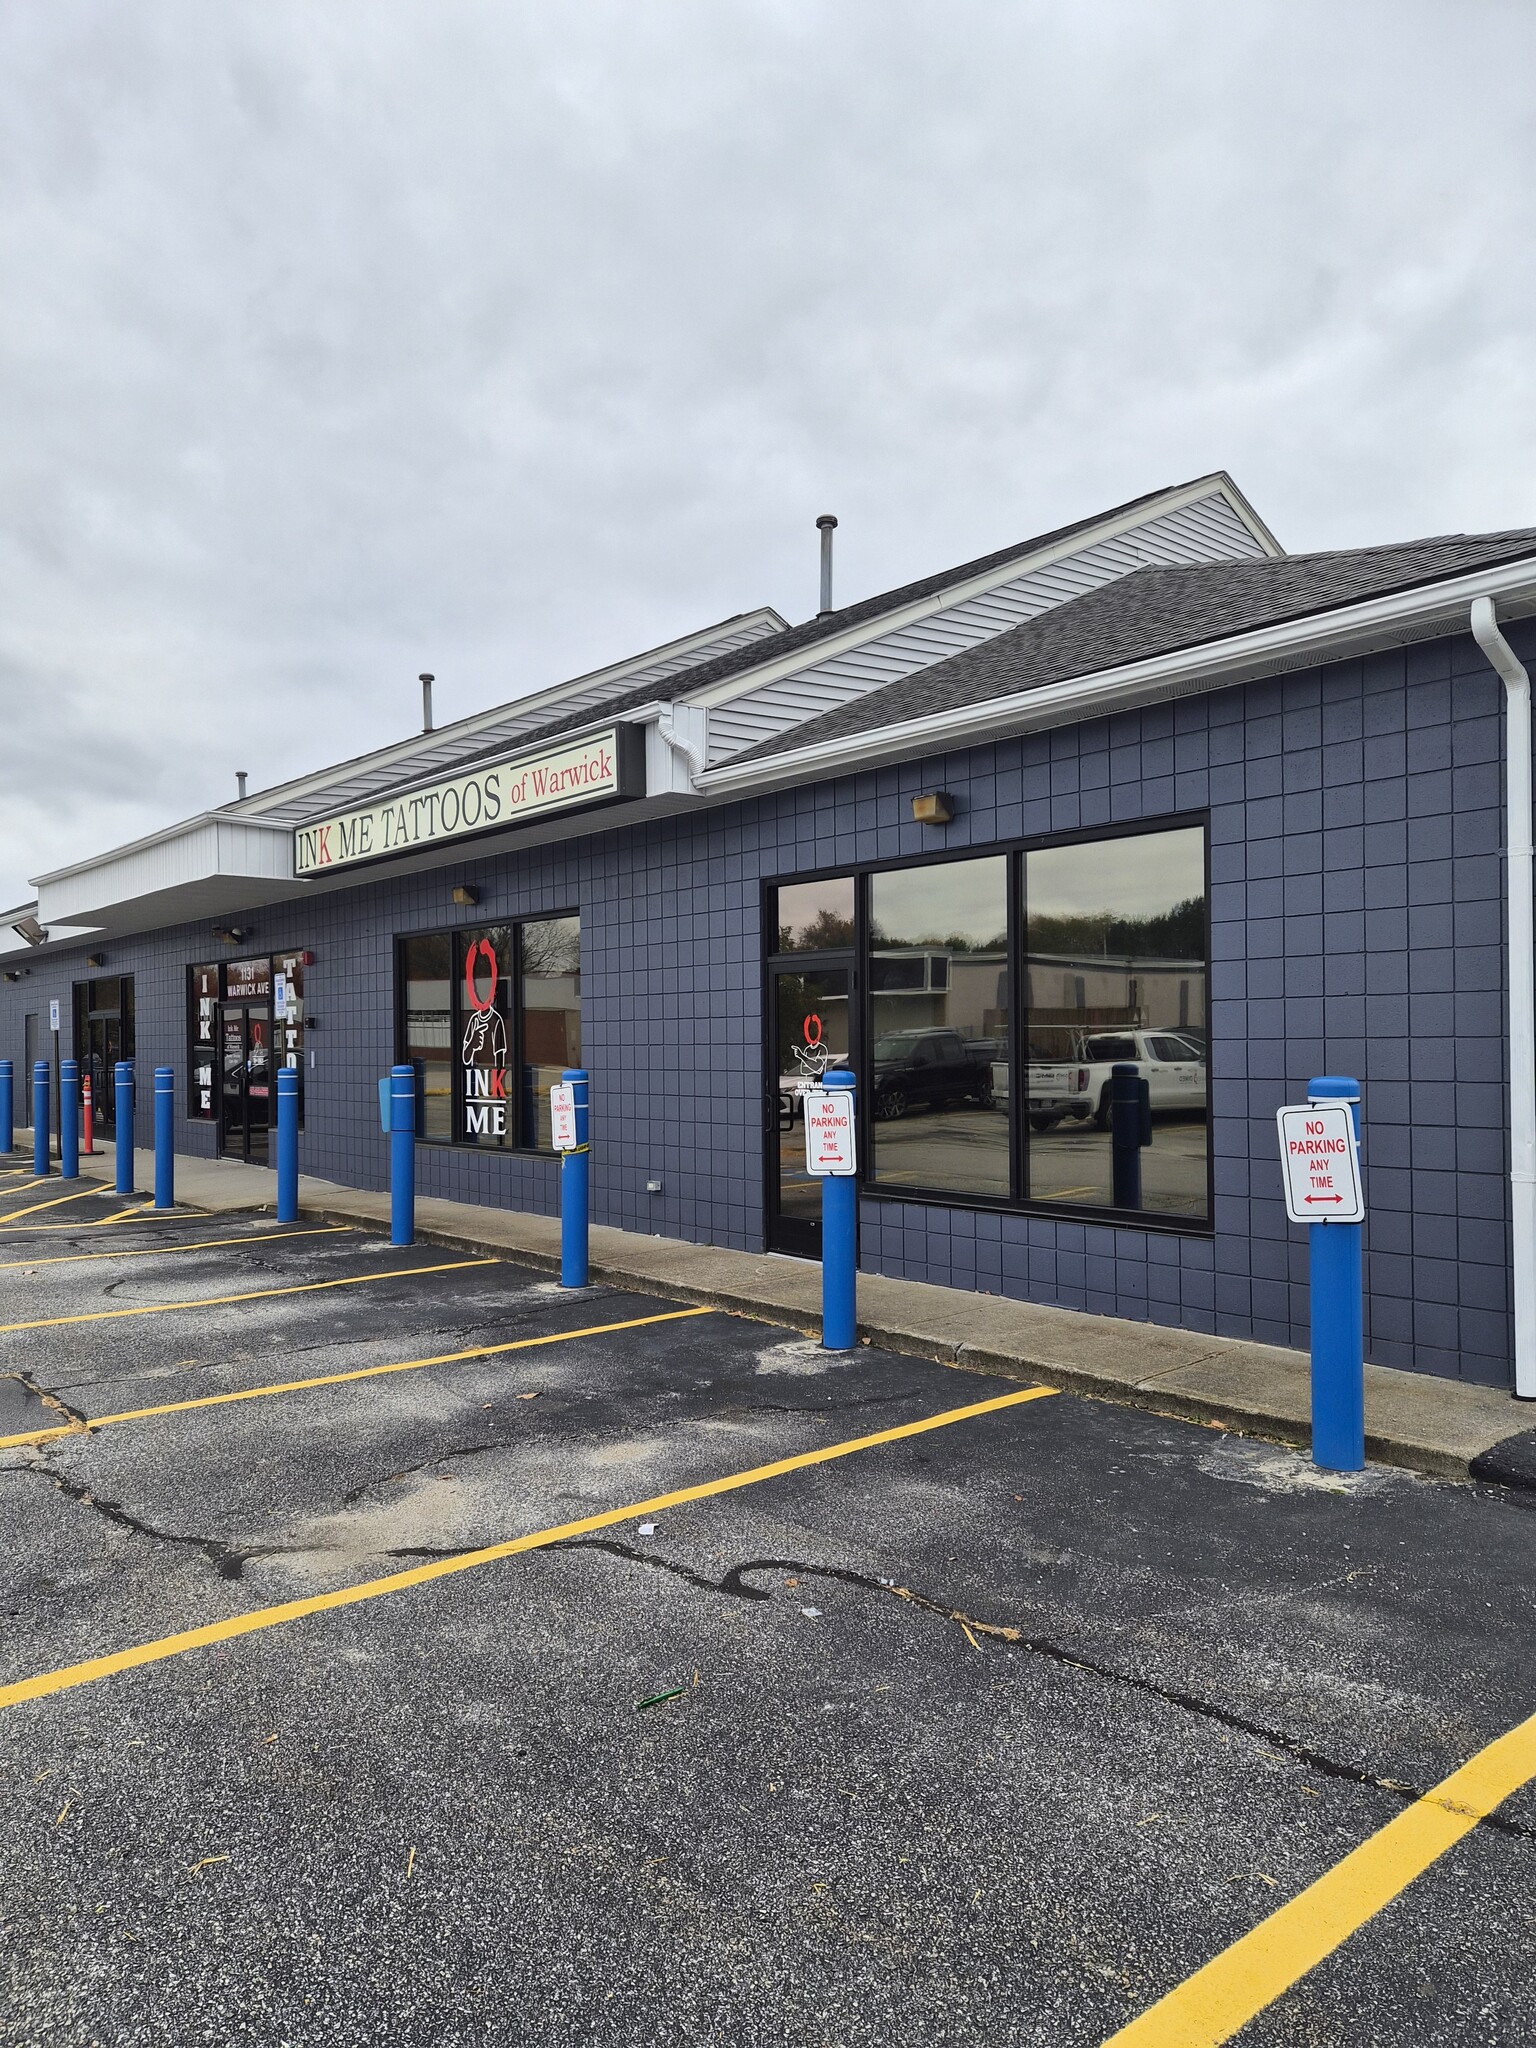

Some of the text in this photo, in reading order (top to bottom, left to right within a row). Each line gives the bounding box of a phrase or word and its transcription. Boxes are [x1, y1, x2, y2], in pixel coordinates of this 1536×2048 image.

[298, 749, 613, 870] INK ME TATTOOS of Warwick
[240, 966, 255, 981] 1131
[227, 983, 256, 997] WARWICK
[257, 981, 270, 995] AVE
[199, 975, 212, 1109] INK ME
[466, 1068, 505, 1097] INK
[554, 1103, 572, 1113] PARKING
[822, 1104, 835, 1114] NO
[466, 1106, 507, 1135] ME
[811, 1116, 848, 1128] PARKING
[823, 1131, 837, 1139] ANY
[1306, 1121, 1324, 1135] NO
[823, 1142, 838, 1152] TIME
[1290, 1139, 1346, 1154] PARKING
[1309, 1159, 1330, 1171] ANY
[1310, 1176, 1334, 1188] TIME
